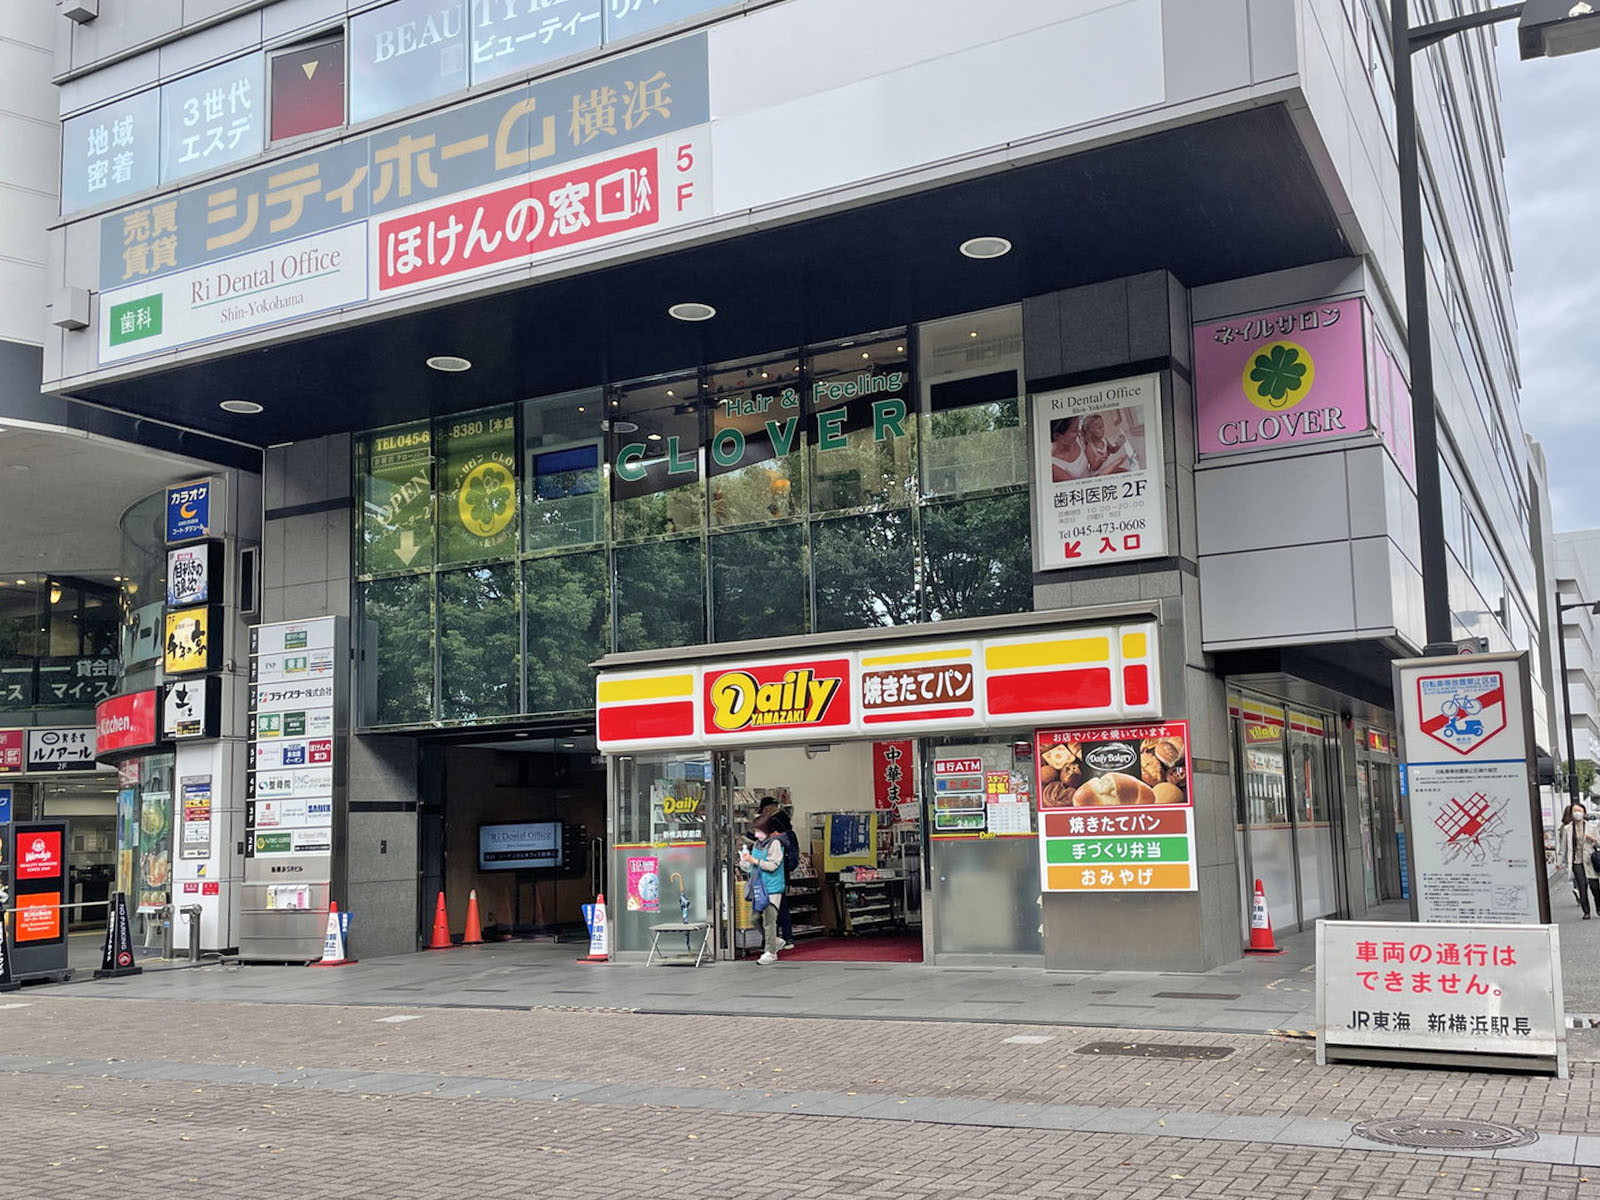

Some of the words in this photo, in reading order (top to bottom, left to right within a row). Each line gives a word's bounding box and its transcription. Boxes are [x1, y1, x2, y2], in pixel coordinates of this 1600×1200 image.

[183, 77, 251, 134] 3世代
[568, 70, 673, 147] 横浜
[87, 115, 135, 158] 地域
[178, 118, 252, 171] エステ
[87, 151, 135, 193] 密着
[123, 200, 179, 246] 売買
[121, 235, 179, 281] 賃貸
[190, 278, 212, 306] Ri
[215, 260, 275, 301] Dental
[280, 247, 342, 284] Office
[119, 303, 154, 338] 歯科
[220, 292, 315, 325] Shin-Yokohama
[1213, 307, 1341, 345] ネイルサロン
[725, 393, 773, 420] Hair
[780, 388, 800, 411] &
[812, 371, 903, 405] Feeling
[1051, 399, 1064, 411] Ri
[1066, 392, 1103, 408] Dental
[1106, 385, 1142, 401] Office
[615, 397, 907, 483] CLOVER
[1217, 406, 1346, 447] CLOVER
[170, 487, 208, 505] カラオケ
[1053, 484, 1118, 509] 歯科医院
[1121, 479, 1148, 499] 2F
[1072, 518, 1146, 538] 045-473-0608
[1098, 533, 1141, 554] 入口
[711, 668, 844, 731] Daily
[862, 666, 972, 706] 焼きたてパン
[752, 709, 807, 727] YAMAZAKI
[1053, 730, 1172, 743] お店でパンを焼いています。
[34, 746, 92, 761] ルノアール
[1090, 752, 1108, 764] Daily
[1107, 752, 1133, 764] Bakery
[663, 796, 700, 815] Daily
[1069, 813, 1161, 834] 焼きたてパン
[1072, 841, 1162, 860] 手づくり弁当
[1081, 868, 1153, 886] おみやげ
[1355, 940, 1517, 967] 車両の通行は
[1355, 970, 1502, 997] できません。
[1346, 1010, 1411, 1032] JR東海
[1427, 1012, 1534, 1037] 新横浜駅長
